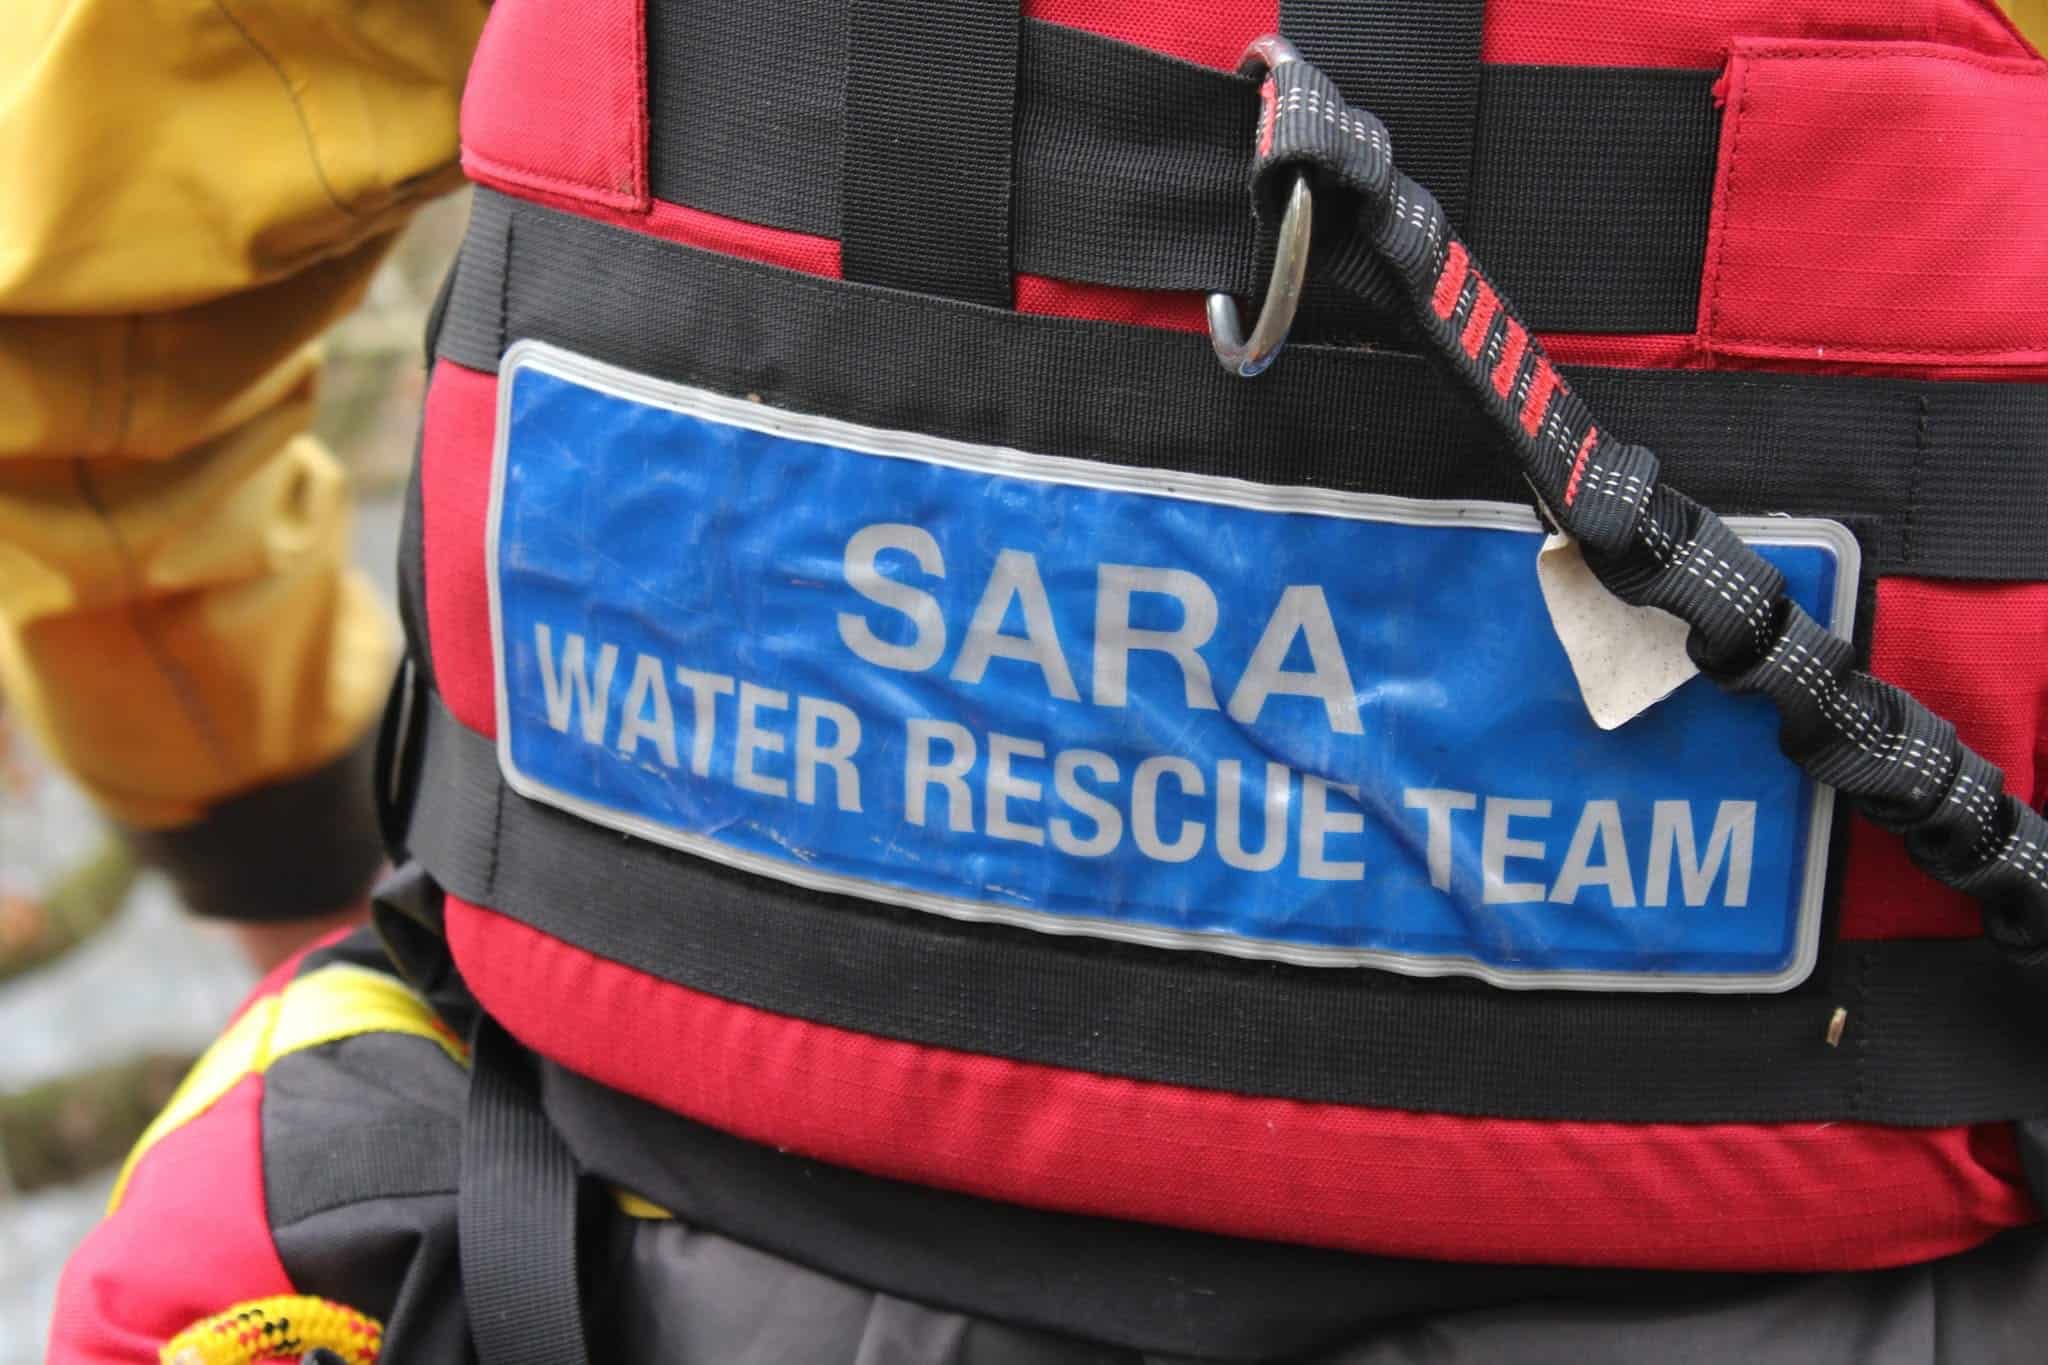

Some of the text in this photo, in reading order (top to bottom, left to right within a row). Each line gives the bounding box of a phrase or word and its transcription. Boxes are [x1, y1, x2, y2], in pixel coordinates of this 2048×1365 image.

[837, 522, 1365, 737] SARA
[533, 622, 1758, 909] WATER RESCUE TEAM
